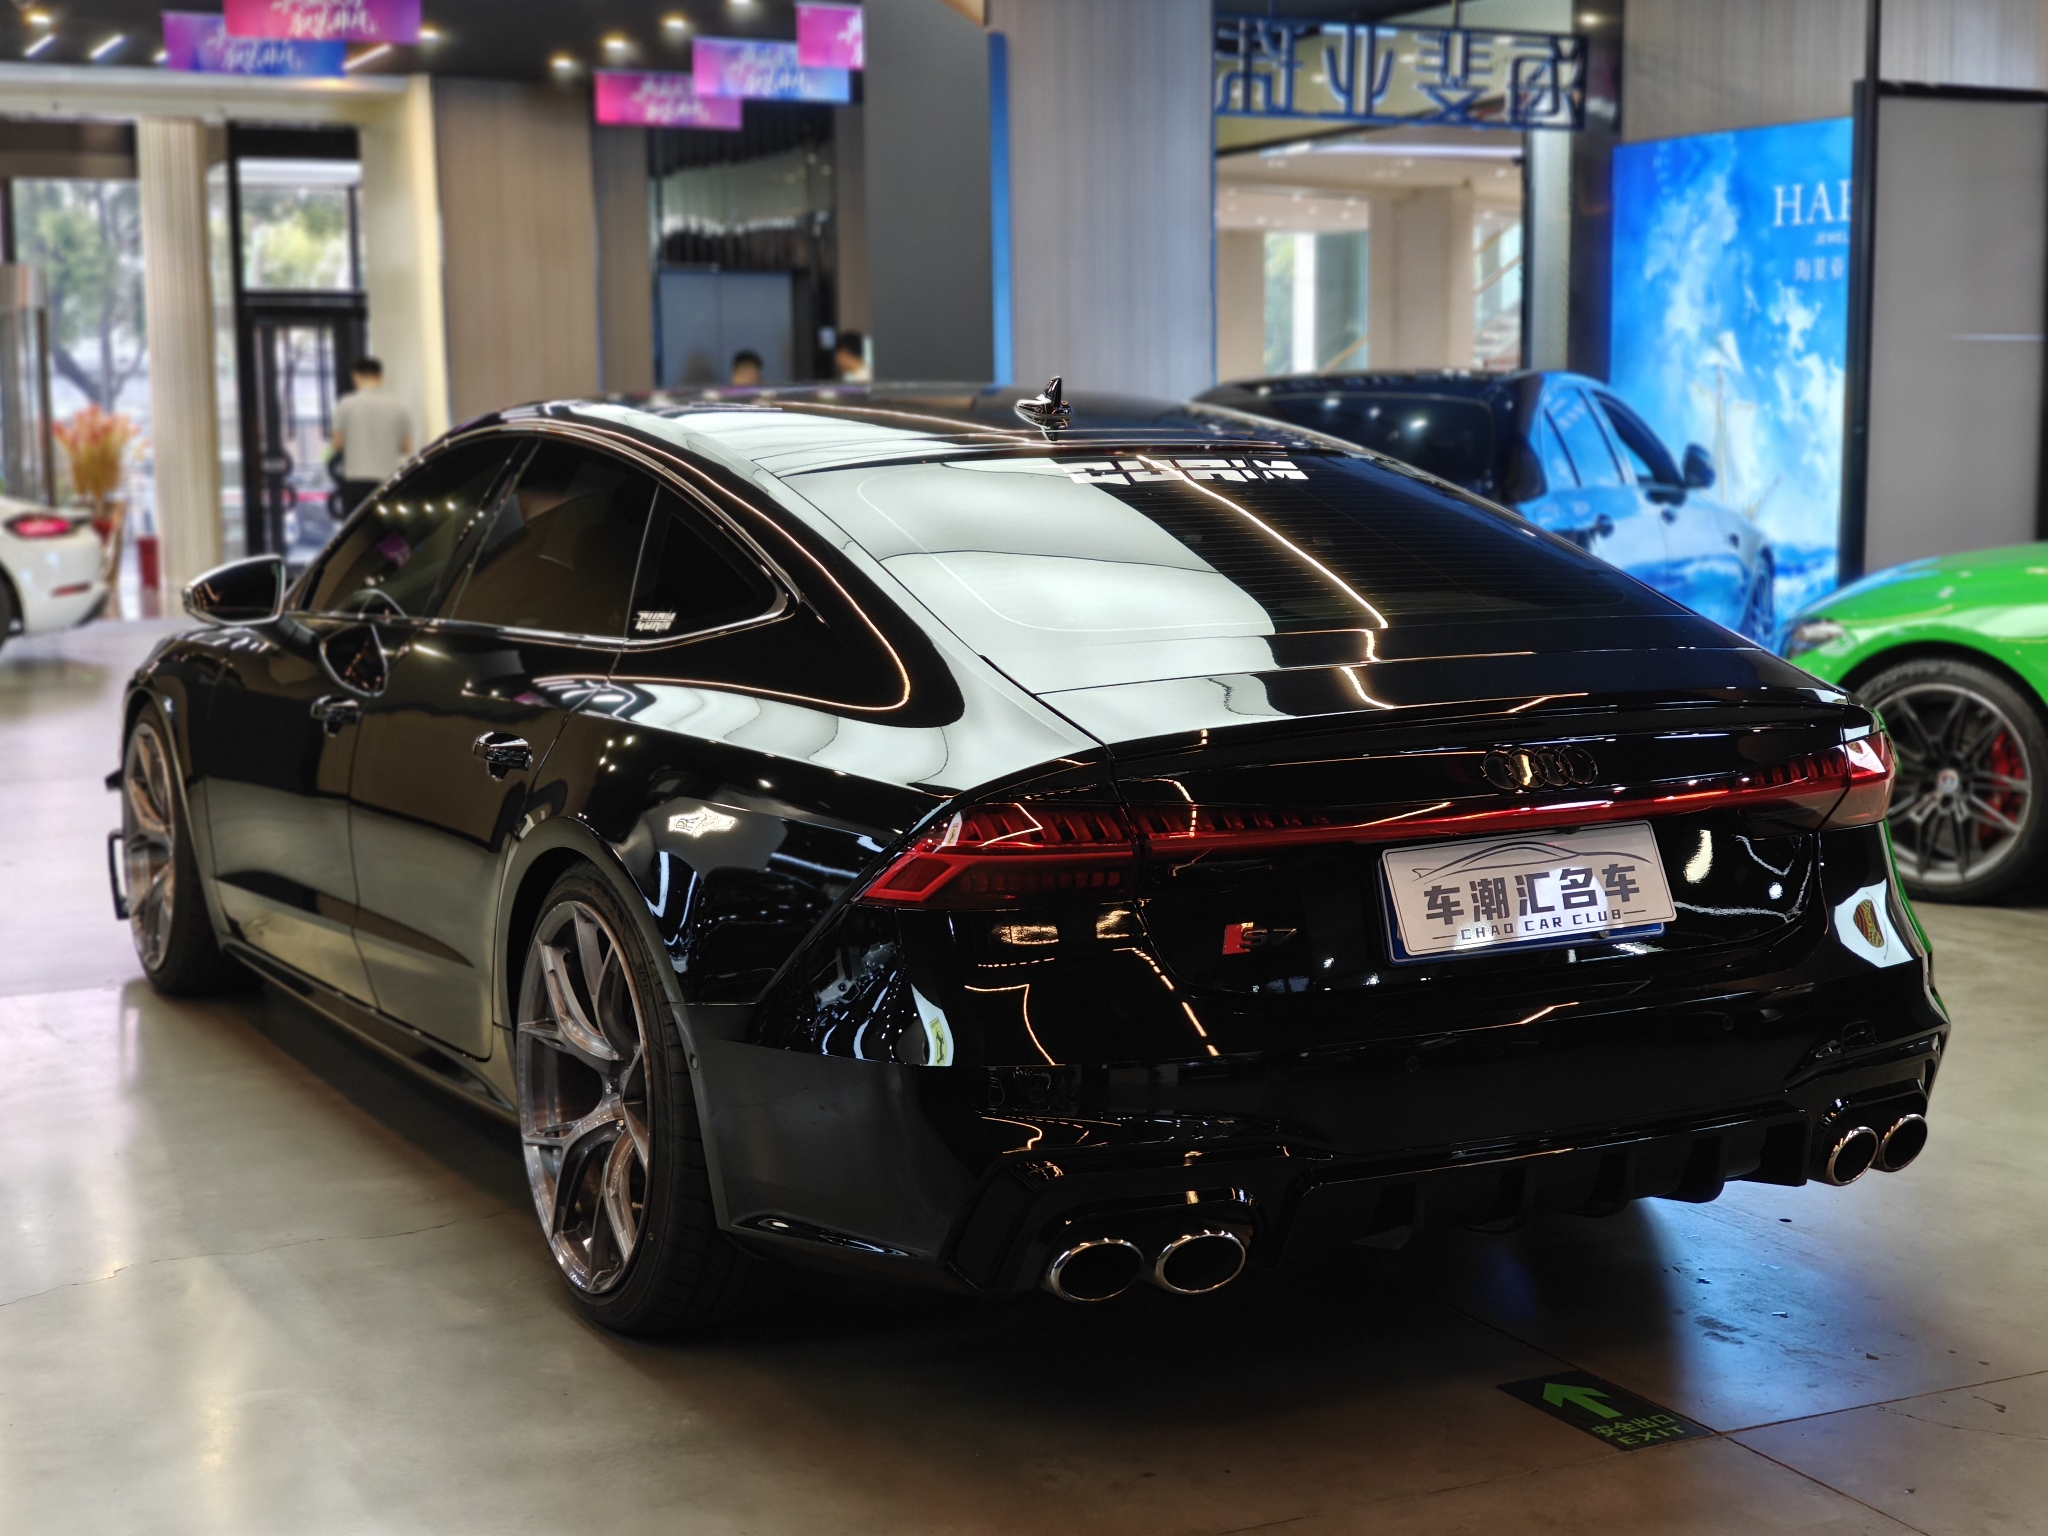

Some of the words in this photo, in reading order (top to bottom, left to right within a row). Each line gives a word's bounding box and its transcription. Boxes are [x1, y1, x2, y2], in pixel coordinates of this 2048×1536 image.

[1424, 863, 1640, 925] 车潮汇名车
[1461, 925, 1514, 940] CHAO
[1525, 916, 1563, 932] CAR
[1573, 909, 1622, 925] CLUB
[1592, 1414, 1676, 1437] 安全出口
[1618, 1425, 1685, 1445] EXIT
